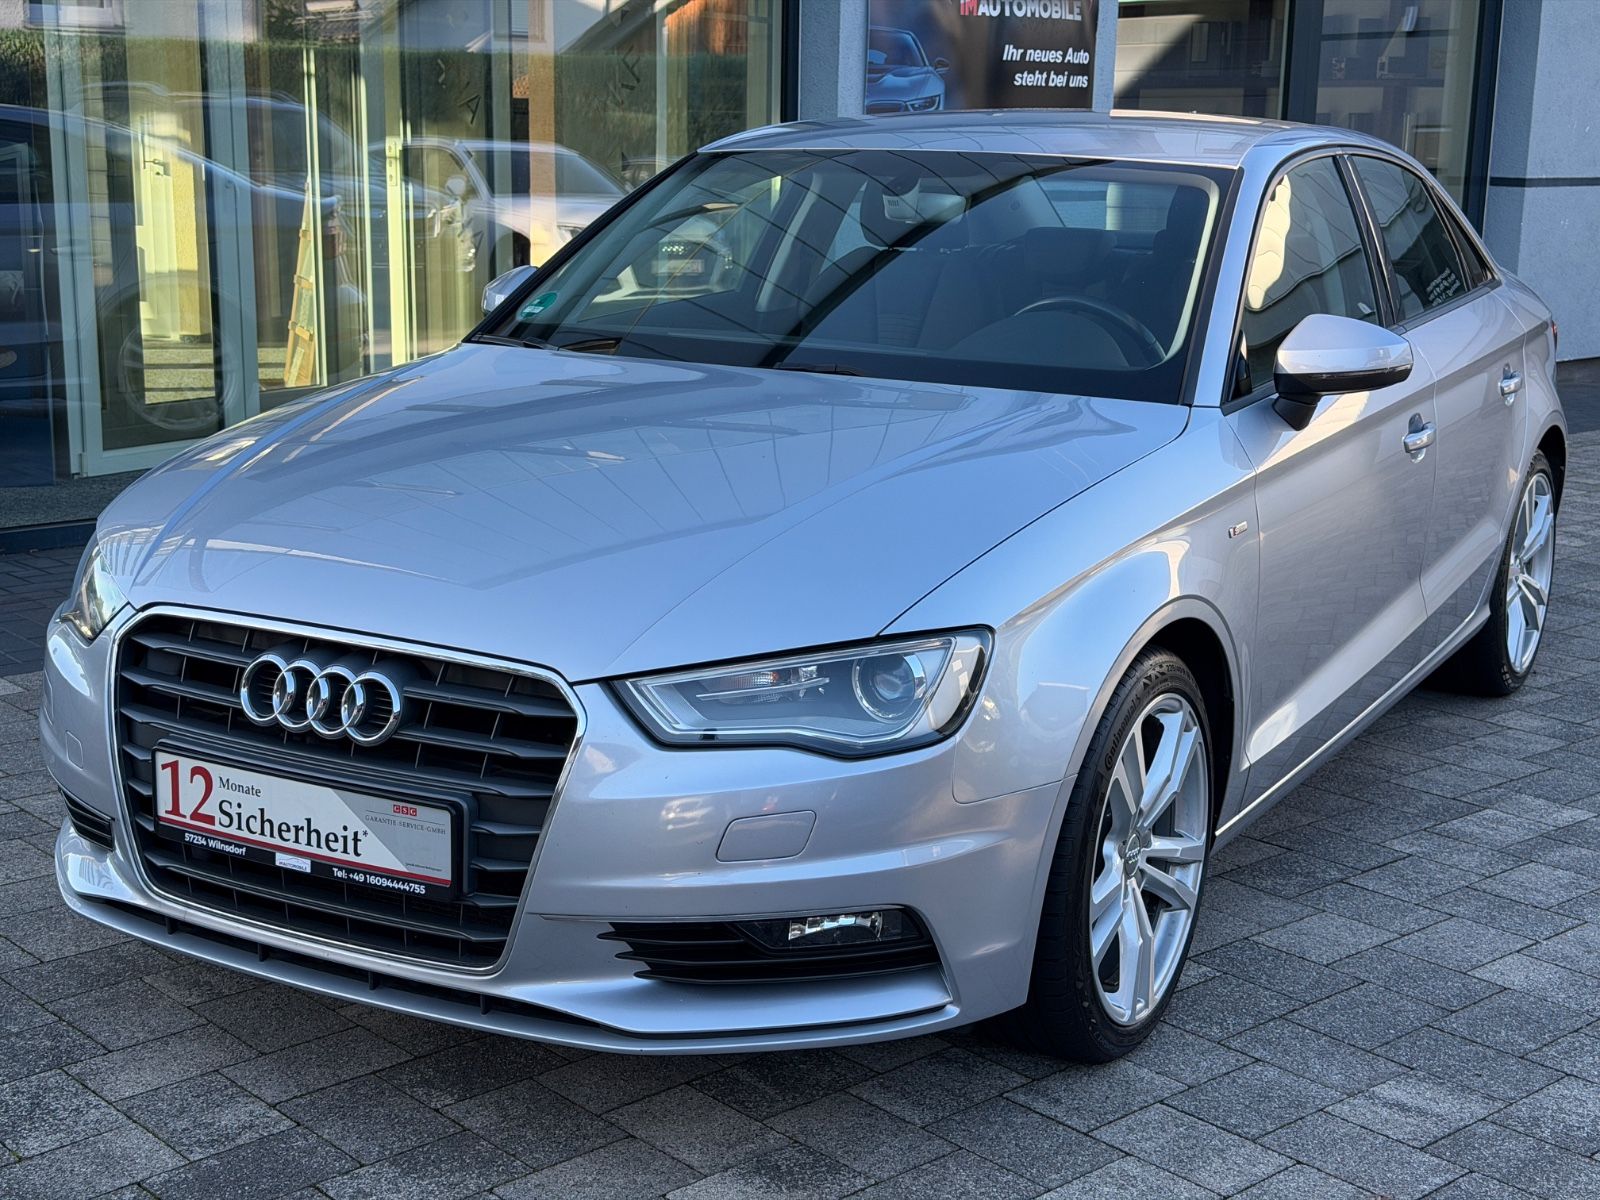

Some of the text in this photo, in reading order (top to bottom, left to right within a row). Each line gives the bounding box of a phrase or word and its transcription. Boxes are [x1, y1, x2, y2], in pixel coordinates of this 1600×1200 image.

[1003, 44, 1090, 64] Ihr neues Auto
[1013, 70, 1089, 88] steht bei uns
[161, 760, 261, 826] 12 Monate
[184, 833, 247, 856] 57234 Wilnsdorf
[332, 868, 426, 894] Tel: +49 16094444755
